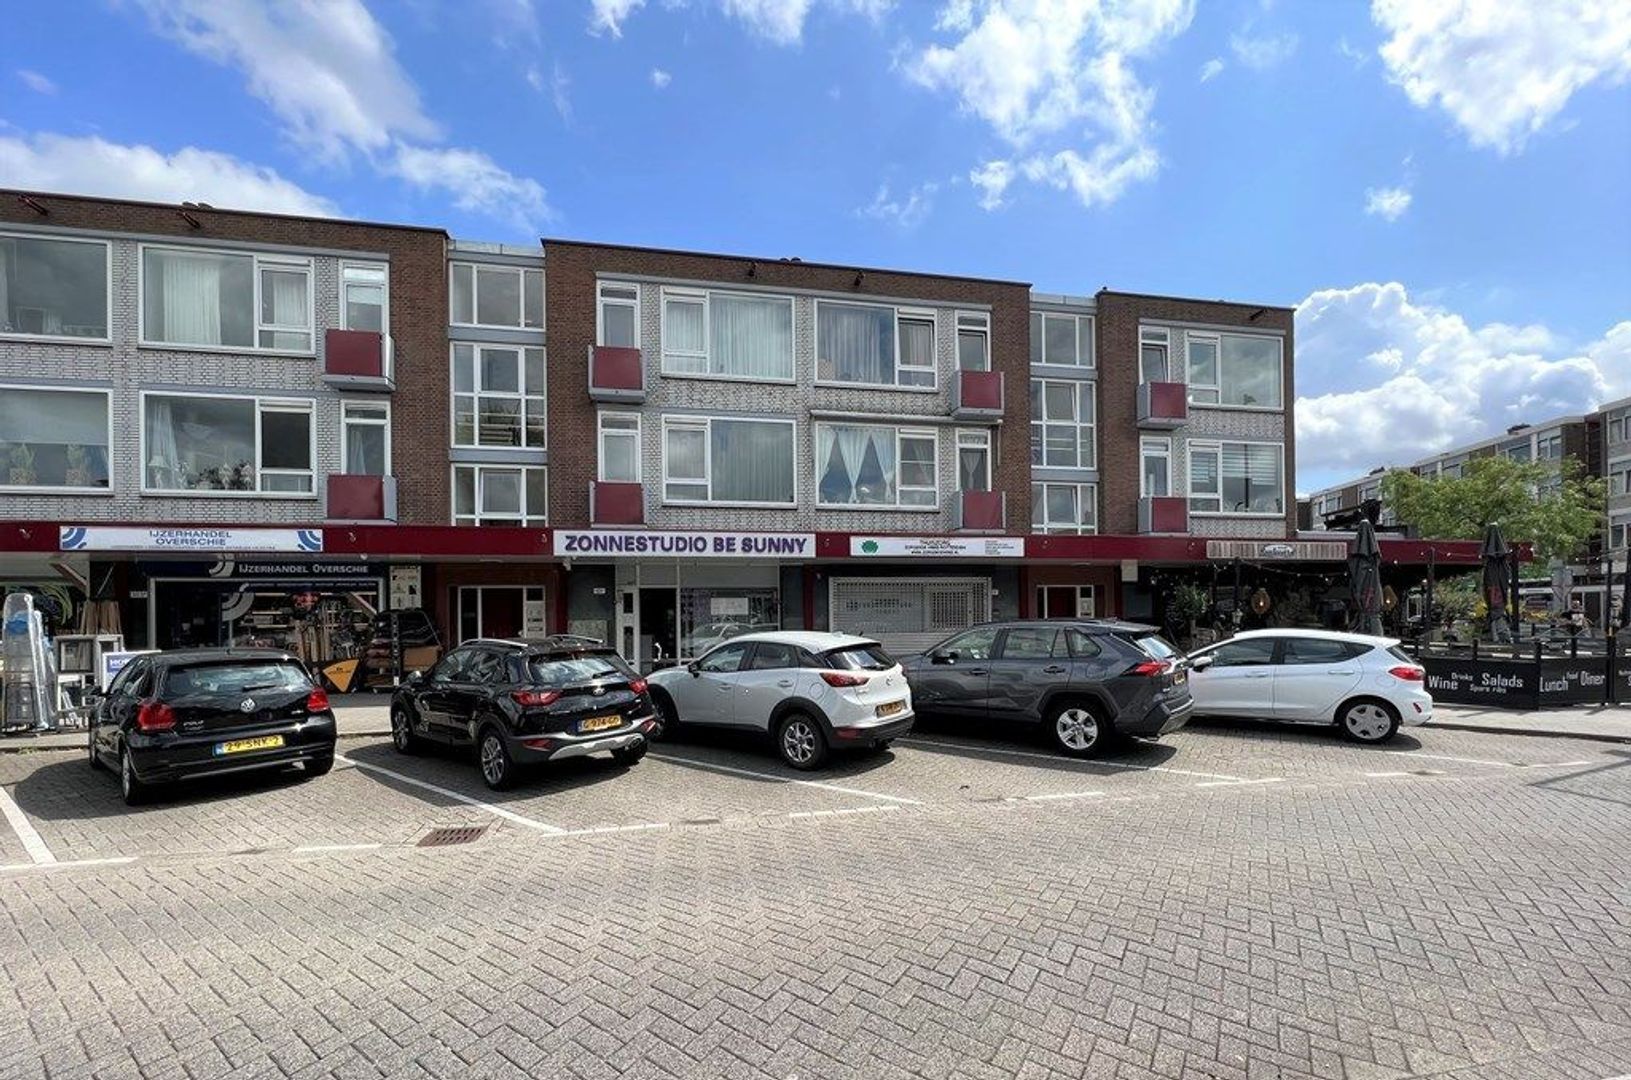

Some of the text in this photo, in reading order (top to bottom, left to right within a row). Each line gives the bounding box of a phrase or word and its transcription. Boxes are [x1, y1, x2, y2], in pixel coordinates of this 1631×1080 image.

[149, 530, 232, 538] IJZERHANDEL
[156, 538, 226, 546] OVERSCHIE
[565, 535, 807, 553] ZONNESTUDIO BE SUNNY
[1428, 675, 1459, 690] Wine
[1481, 672, 1524, 688] Salads
[1539, 675, 1569, 692] Lunch
